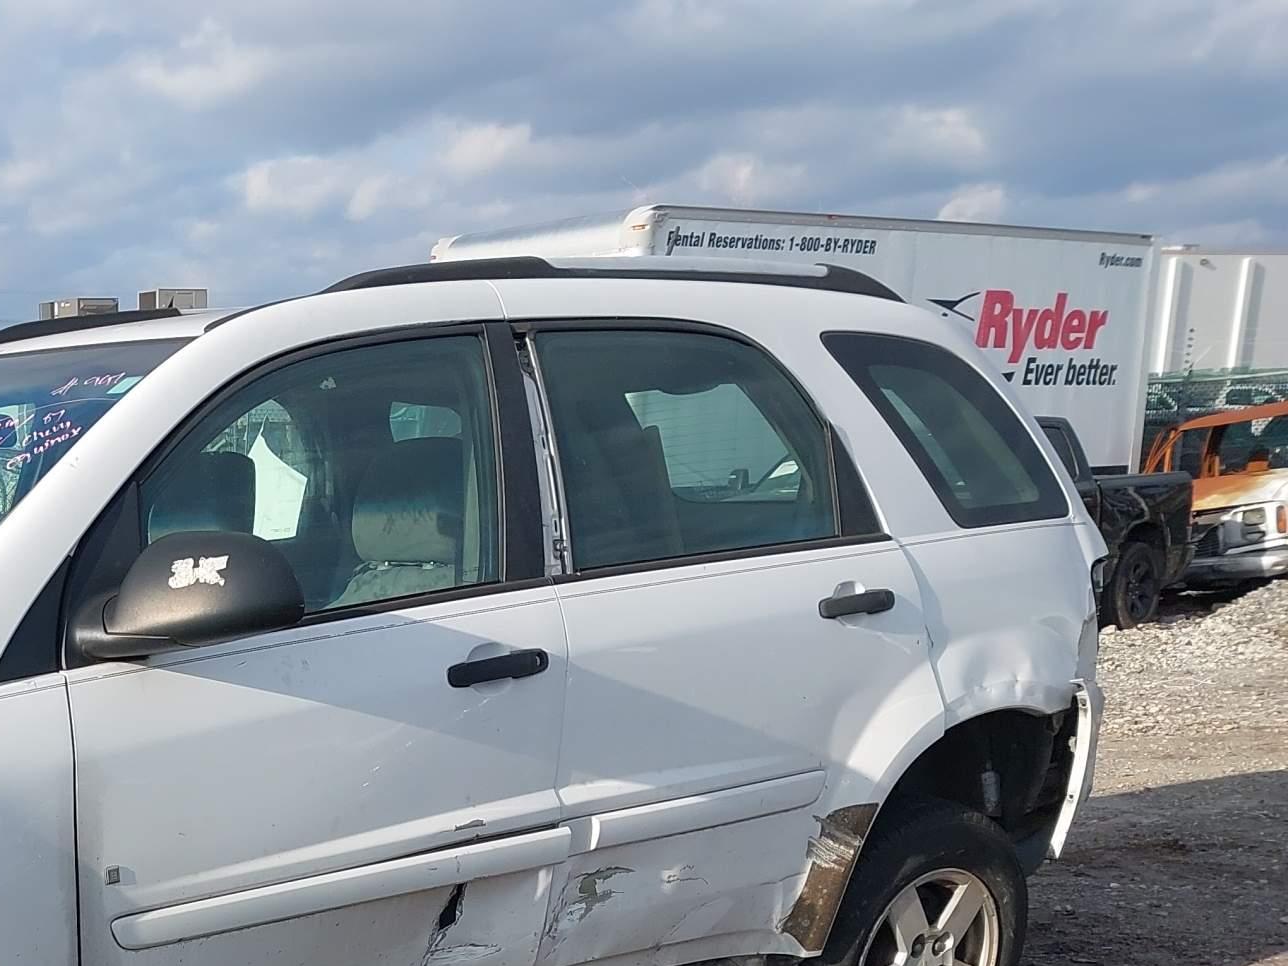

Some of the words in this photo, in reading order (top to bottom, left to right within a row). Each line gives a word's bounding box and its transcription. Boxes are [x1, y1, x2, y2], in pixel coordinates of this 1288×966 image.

[708, 232, 786, 251] Reservations:
[788, 235, 878, 255] 1-800-BY-RYDER
[1098, 251, 1143, 269] Ryder.com
[975, 289, 1109, 364] Ryder
[1021, 357, 1064, 386] Ever
[1063, 357, 1118, 386] better.
